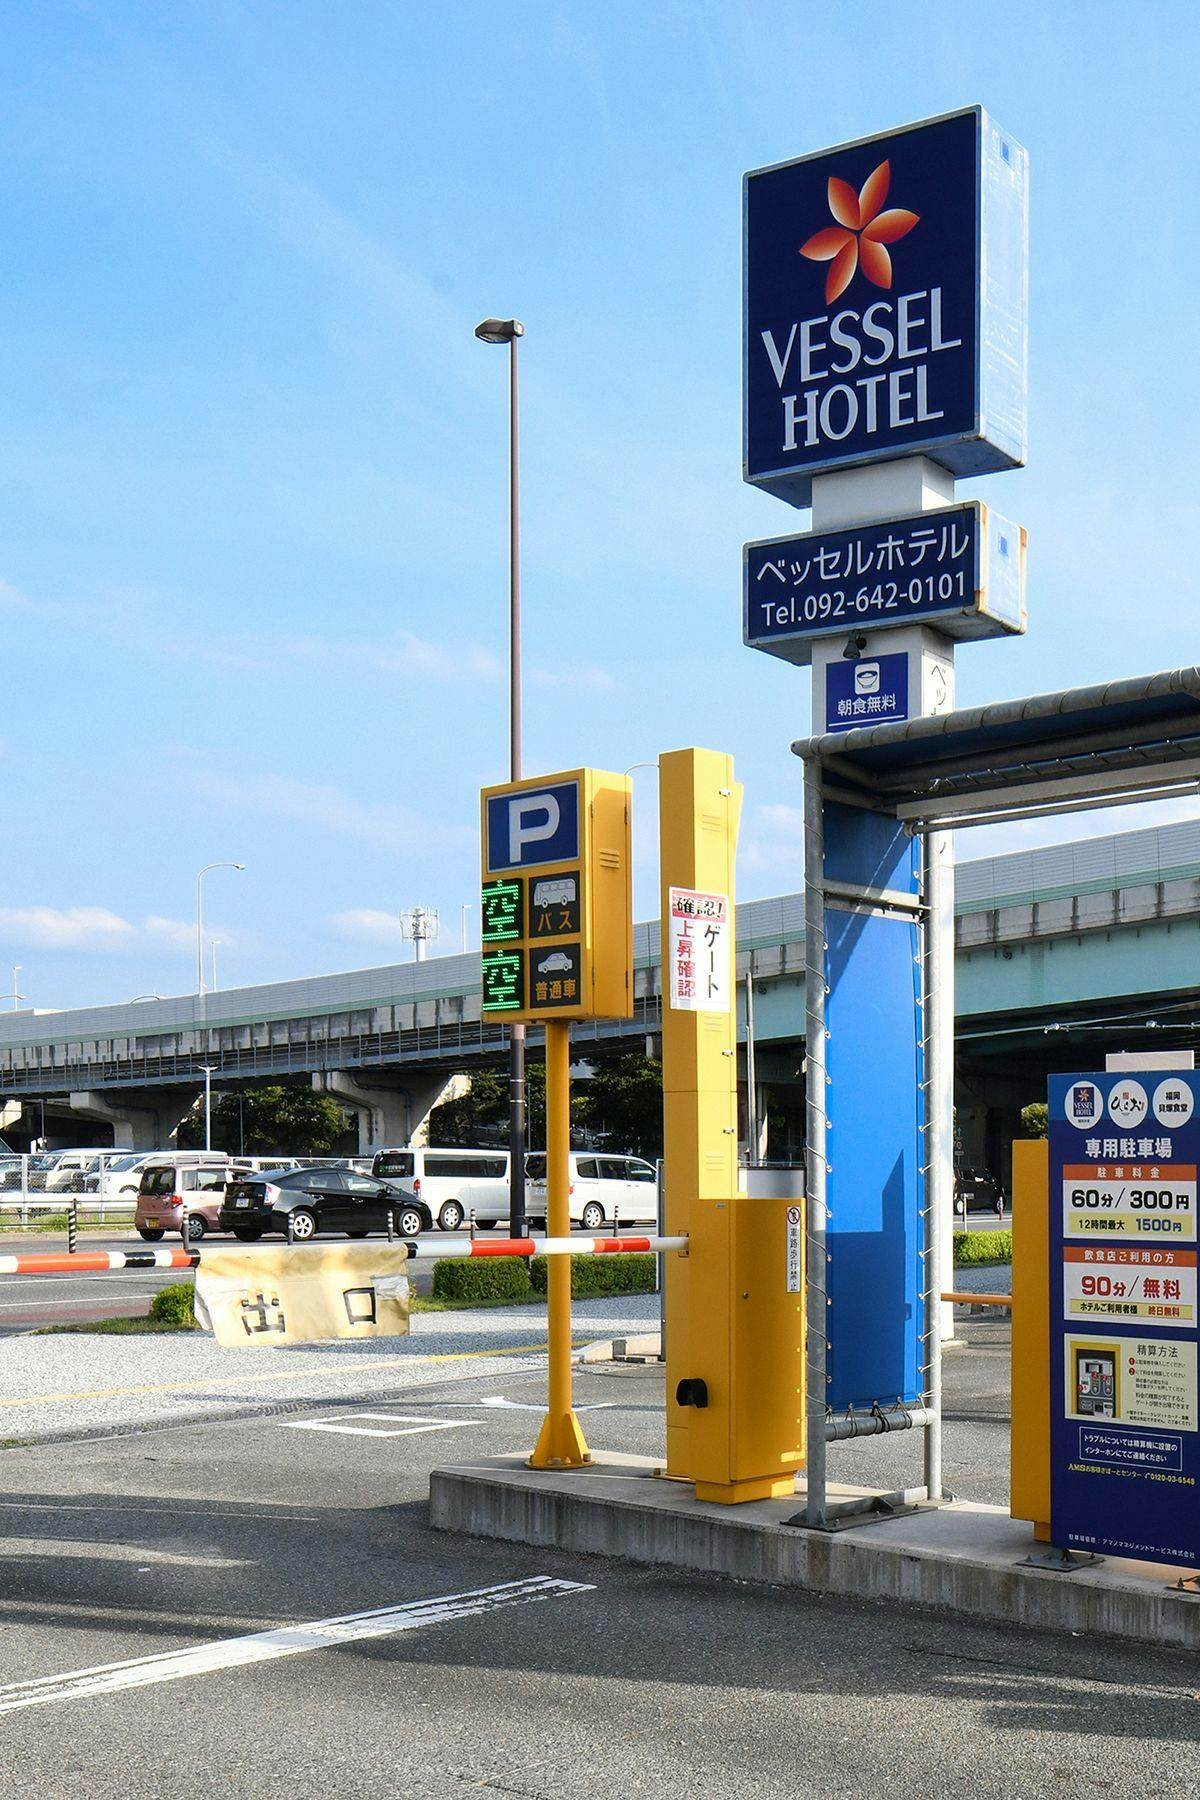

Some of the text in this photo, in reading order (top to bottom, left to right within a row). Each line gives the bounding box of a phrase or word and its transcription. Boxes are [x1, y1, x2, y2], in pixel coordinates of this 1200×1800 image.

[760, 287, 962, 388] VESSEL
[782, 364, 944, 451] HOTEL
[756, 523, 970, 586] ベッセルホテル
[761, 571, 965, 627] Tel.092-642-0101
[837, 693, 897, 716] 朝食無料
[508, 793, 561, 863] P
[482, 879, 520, 943] 空
[537, 911, 573, 932] バス
[676, 919, 696, 998] 上昇確認
[704, 924, 720, 999] ゲート
[482, 949, 521, 1011] 空
[535, 977, 577, 1001] 普通車
[1085, 1138, 1173, 1159] 専用駐車場
[1097, 1166, 1160, 1178] 駐車料金
[1078, 1218, 1182, 1232] 12時間最大 1500円
[1084, 1249, 1175, 1264] 飲食店ご利用の方
[1080, 1302, 1180, 1317] ホテルご利用者様 終日無料
[1137, 1343, 1178, 1358] 精算方法
